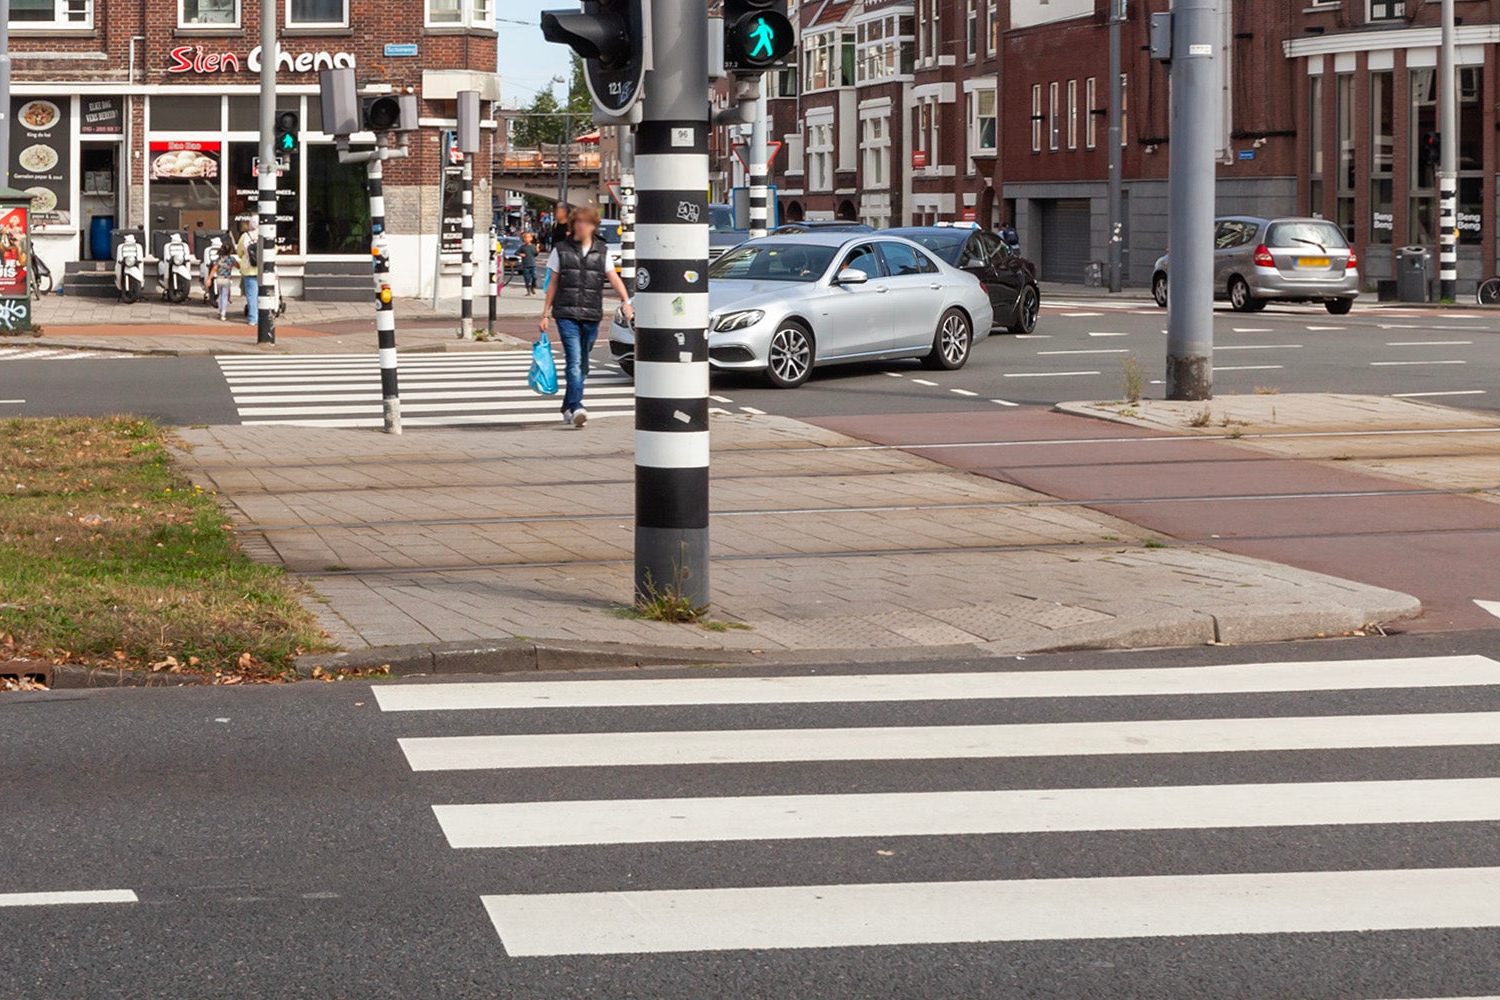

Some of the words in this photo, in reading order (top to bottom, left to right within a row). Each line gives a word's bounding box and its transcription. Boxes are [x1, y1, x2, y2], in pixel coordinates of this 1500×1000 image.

[167, 45, 239, 73] Sien
[1373, 212, 1393, 221] Beng
[1457, 212, 1481, 222] Beng
[1373, 221, 1393, 230] Beng
[1457, 221, 1481, 231] Beng
[4, 260, 16, 268] JE
